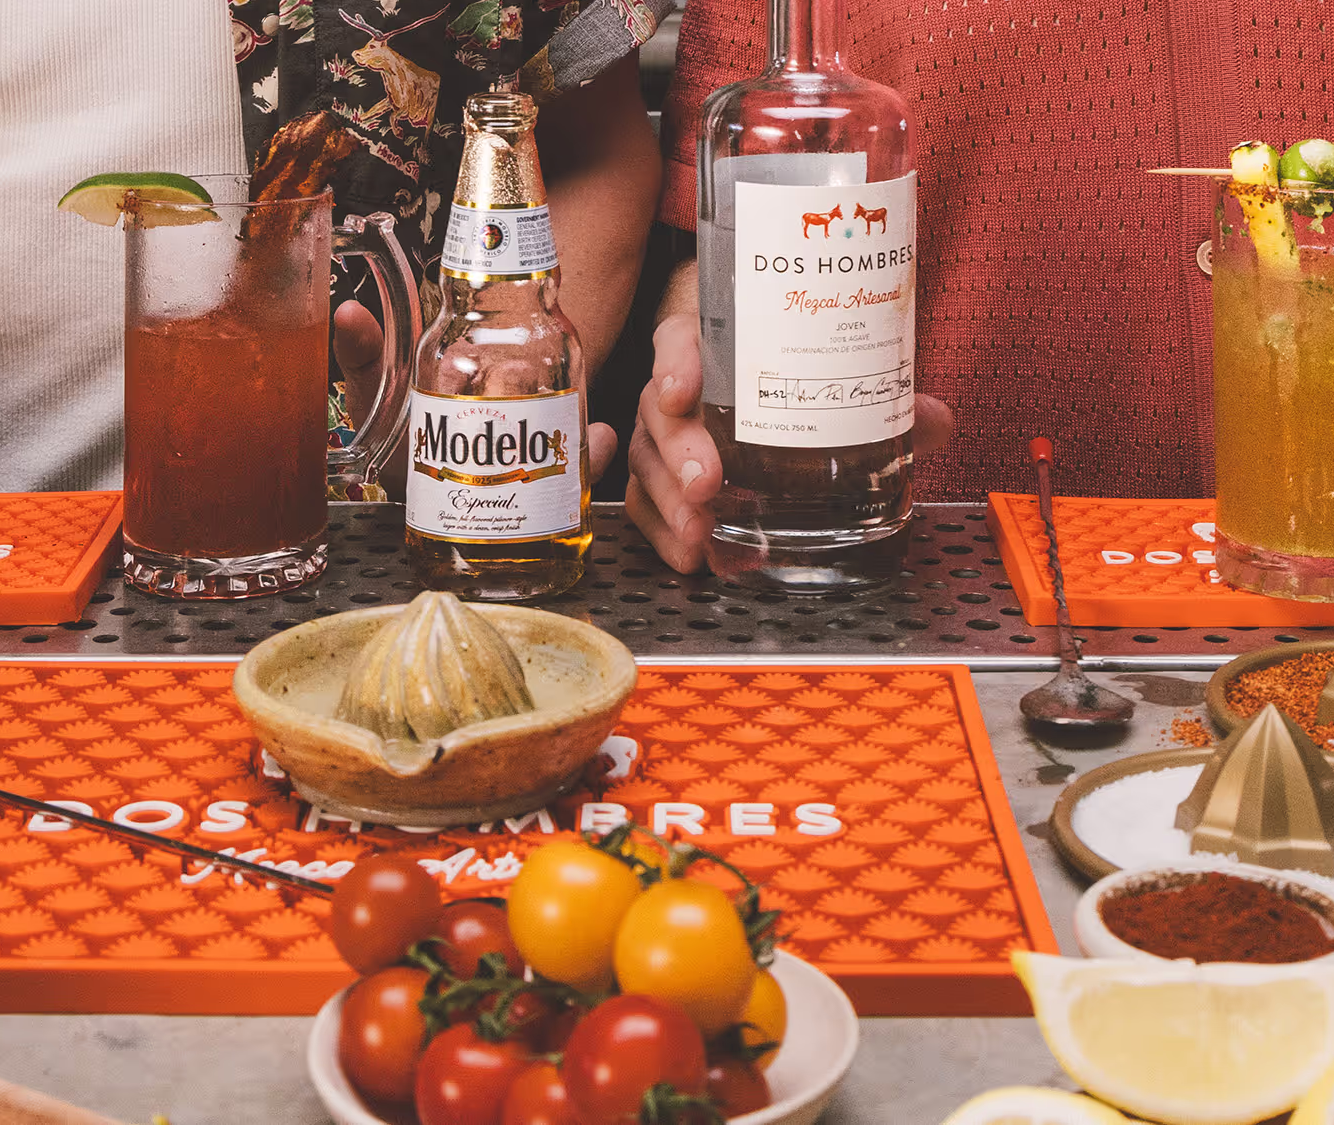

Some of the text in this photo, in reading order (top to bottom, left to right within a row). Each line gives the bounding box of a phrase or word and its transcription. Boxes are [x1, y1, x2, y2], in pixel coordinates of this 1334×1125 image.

[754, 244, 913, 274] DOS HOMBRES
[783, 283, 902, 315] Mezcal Artesanal
[836, 320, 866, 332] JOVEN
[455, 407, 507, 422] CERVEZA
[424, 411, 549, 467] Modelo
[472, 477, 492, 485] 1925
[1101, 548, 1217, 565] DOS
[28, 800, 250, 834] DOS
